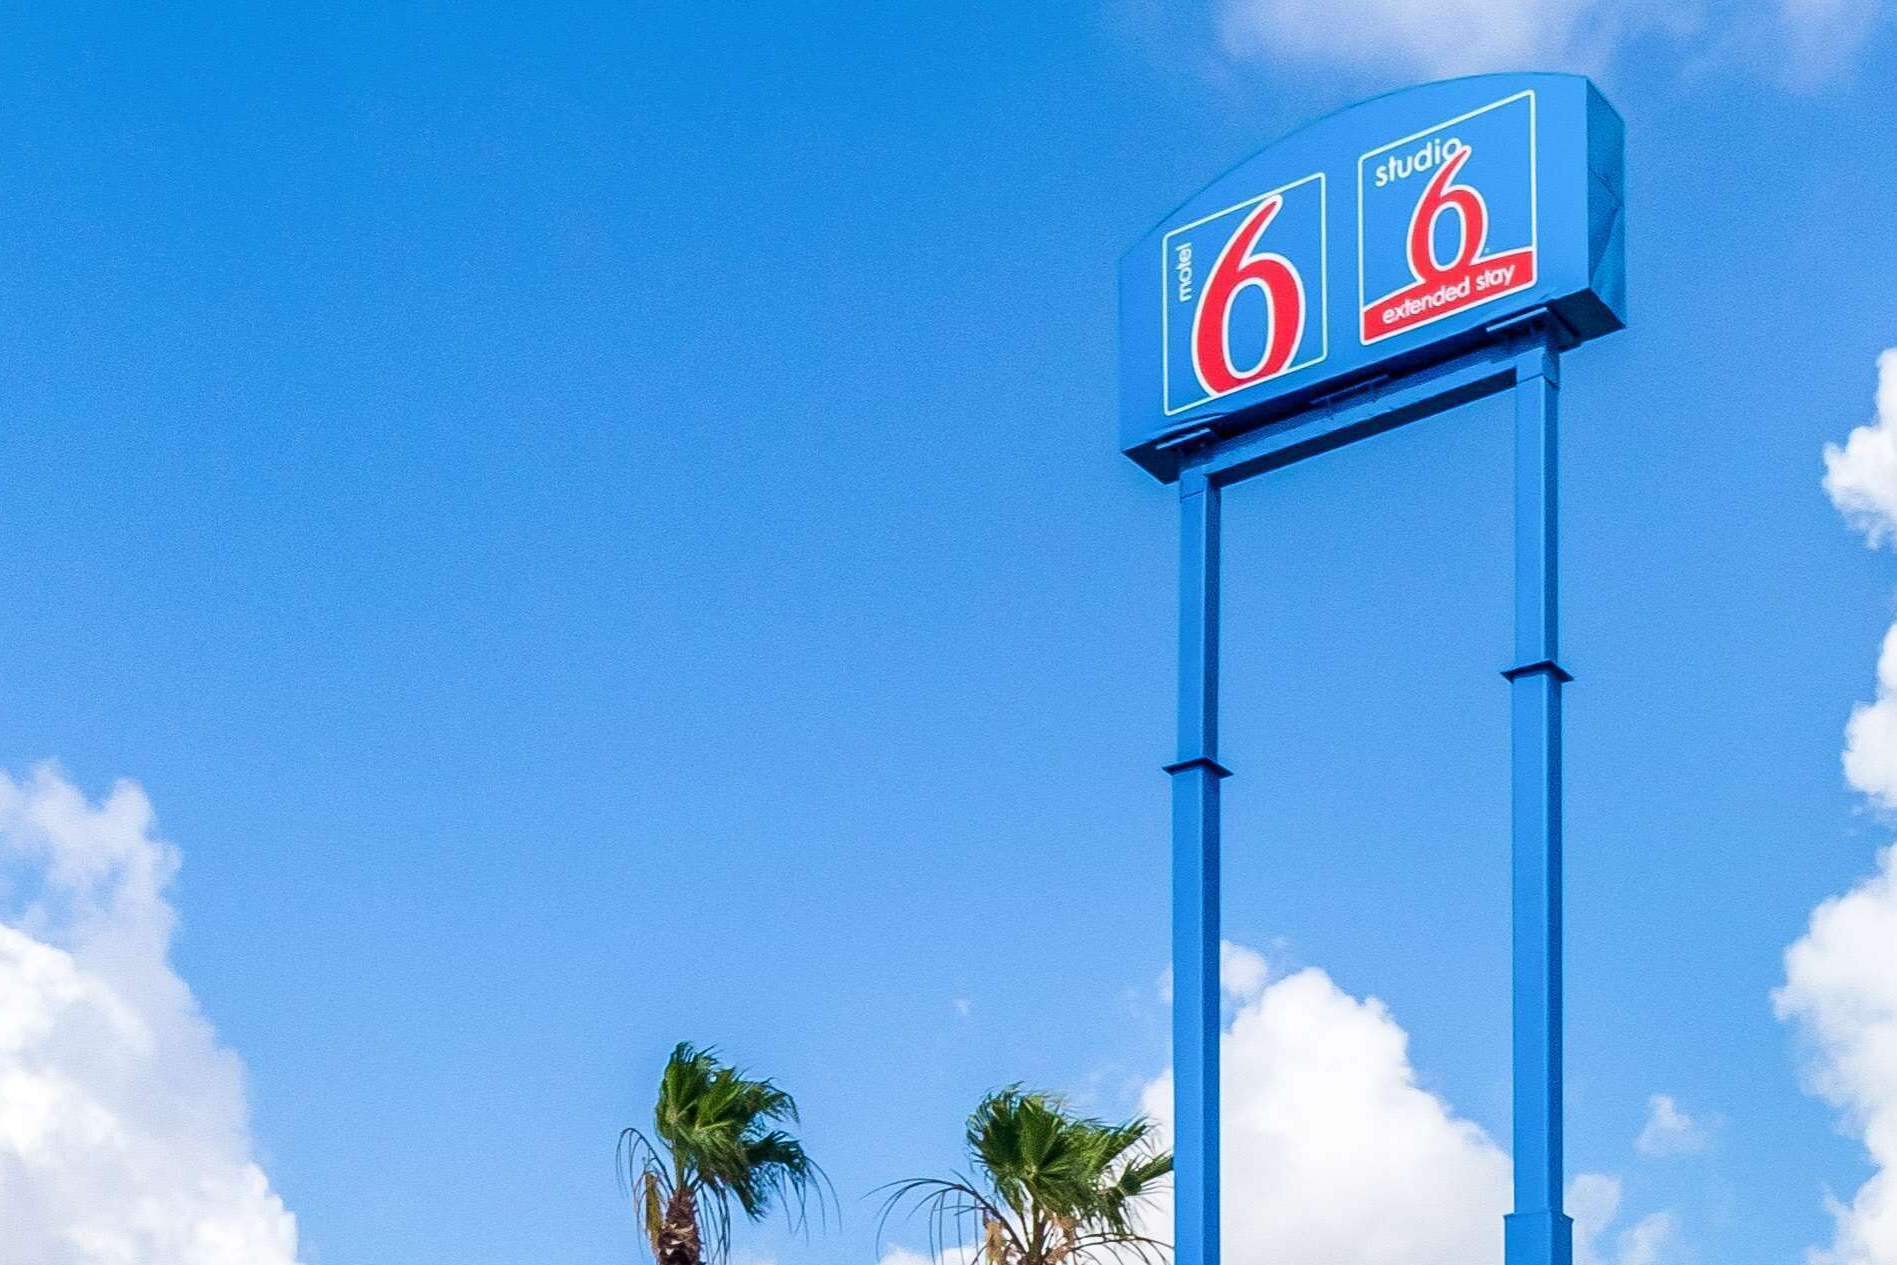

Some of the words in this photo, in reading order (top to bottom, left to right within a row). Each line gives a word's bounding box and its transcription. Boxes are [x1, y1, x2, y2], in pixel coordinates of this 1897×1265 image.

[1374, 137, 1462, 187] studio
[1406, 145, 1488, 284] 6
[1175, 242, 1192, 302] motel
[1191, 194, 1306, 397] 6
[1382, 276, 1470, 324] extended
[1476, 264, 1516, 294] stay
